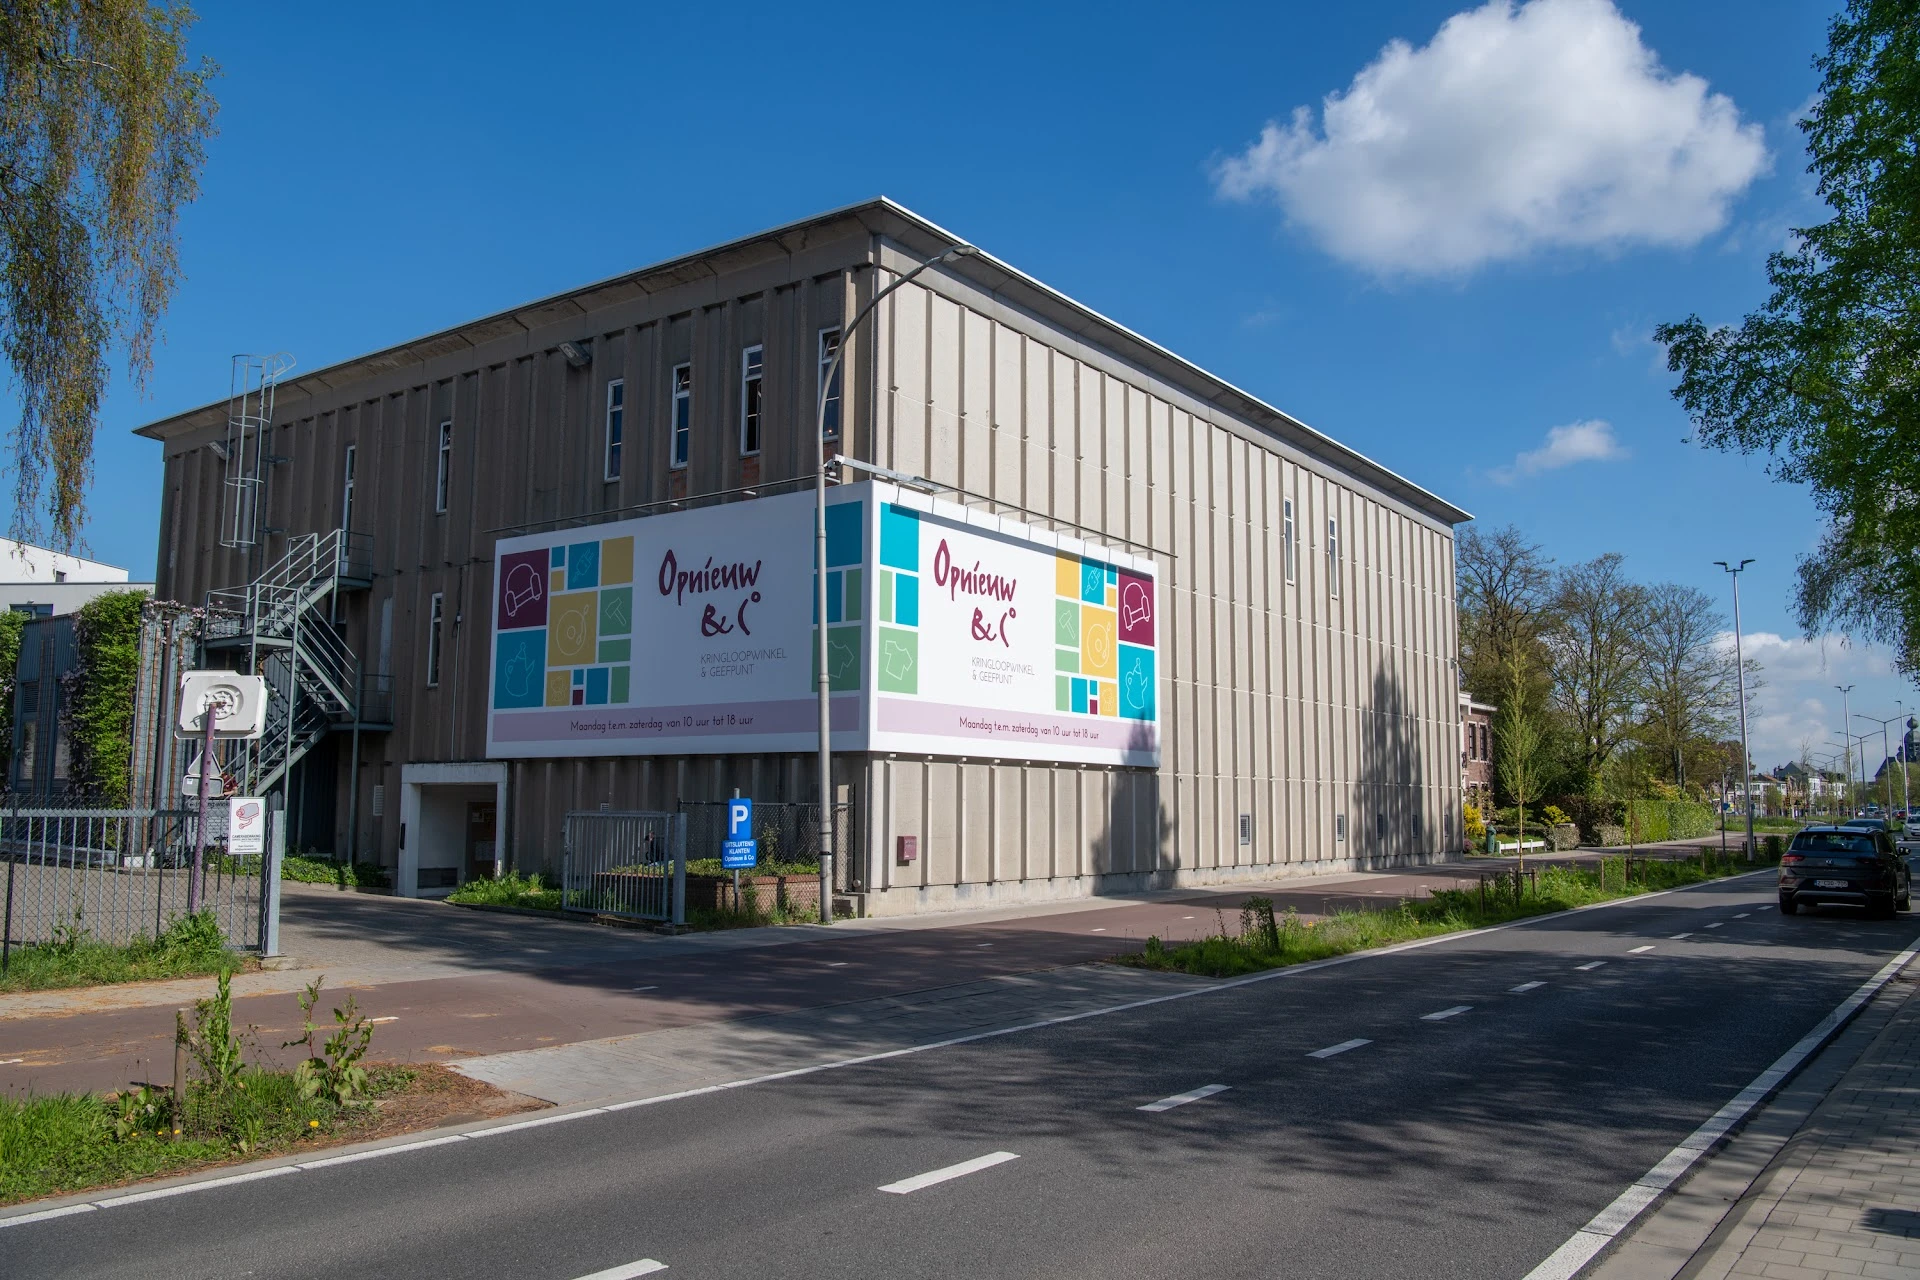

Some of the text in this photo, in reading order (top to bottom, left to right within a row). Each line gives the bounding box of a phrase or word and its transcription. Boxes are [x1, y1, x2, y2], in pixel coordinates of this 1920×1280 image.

[658, 549, 762, 606] Opnieuw
[934, 538, 1017, 601] Opnieuw
[701, 603, 734, 637] &
[971, 607, 997, 641] &
[700, 648, 788, 664] KRINGLOOPWINKEL
[971, 656, 1035, 676] KRINGLOOPWINKEL
[701, 664, 755, 677] & GEEFPUNT
[972, 669, 1014, 684] & GEEFPUNT
[570, 719, 606, 733] Maandag
[608, 720, 628, 731] t.e.m.
[629, 717, 663, 732] zaterdag
[683, 716, 693, 727] 10
[695, 719, 709, 727] uur
[712, 715, 724, 726] tot
[727, 714, 736, 725] 18
[738, 716, 754, 725] uur
[959, 716, 993, 733] Maandag
[1012, 722, 1039, 737] zaterdag
[1040, 727, 1051, 736] van
[1052, 726, 1060, 736] 10
[1073, 728, 1081, 738] tot
[1082, 728, 1089, 738] 18
[1089, 732, 1099, 740] uur
[732, 805, 748, 834] P
